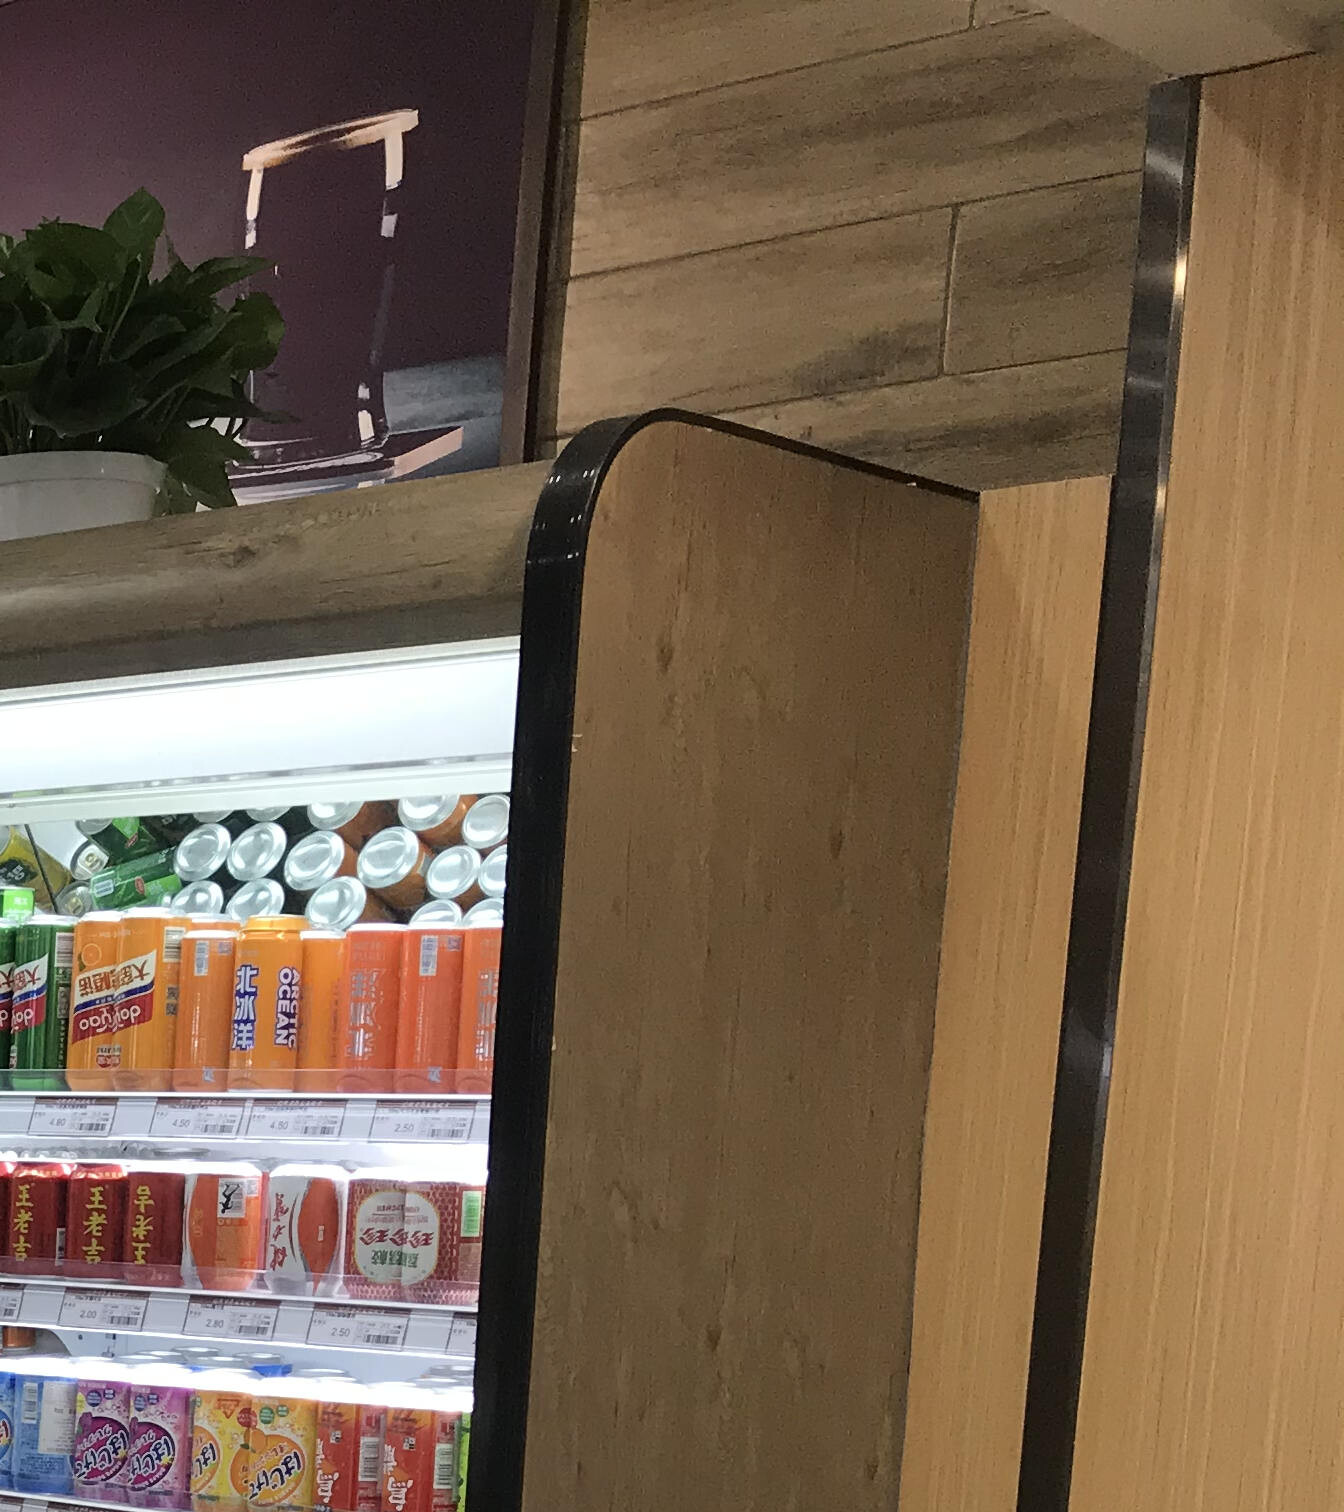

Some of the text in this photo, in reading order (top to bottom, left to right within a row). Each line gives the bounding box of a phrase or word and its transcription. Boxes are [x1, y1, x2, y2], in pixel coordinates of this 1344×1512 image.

[232, 964, 260, 1052] 北冰洋
[274, 966, 293, 1046] OCEAN
[11, 1183, 34, 1263] 王老吉
[82, 1185, 109, 1265] 王老吉
